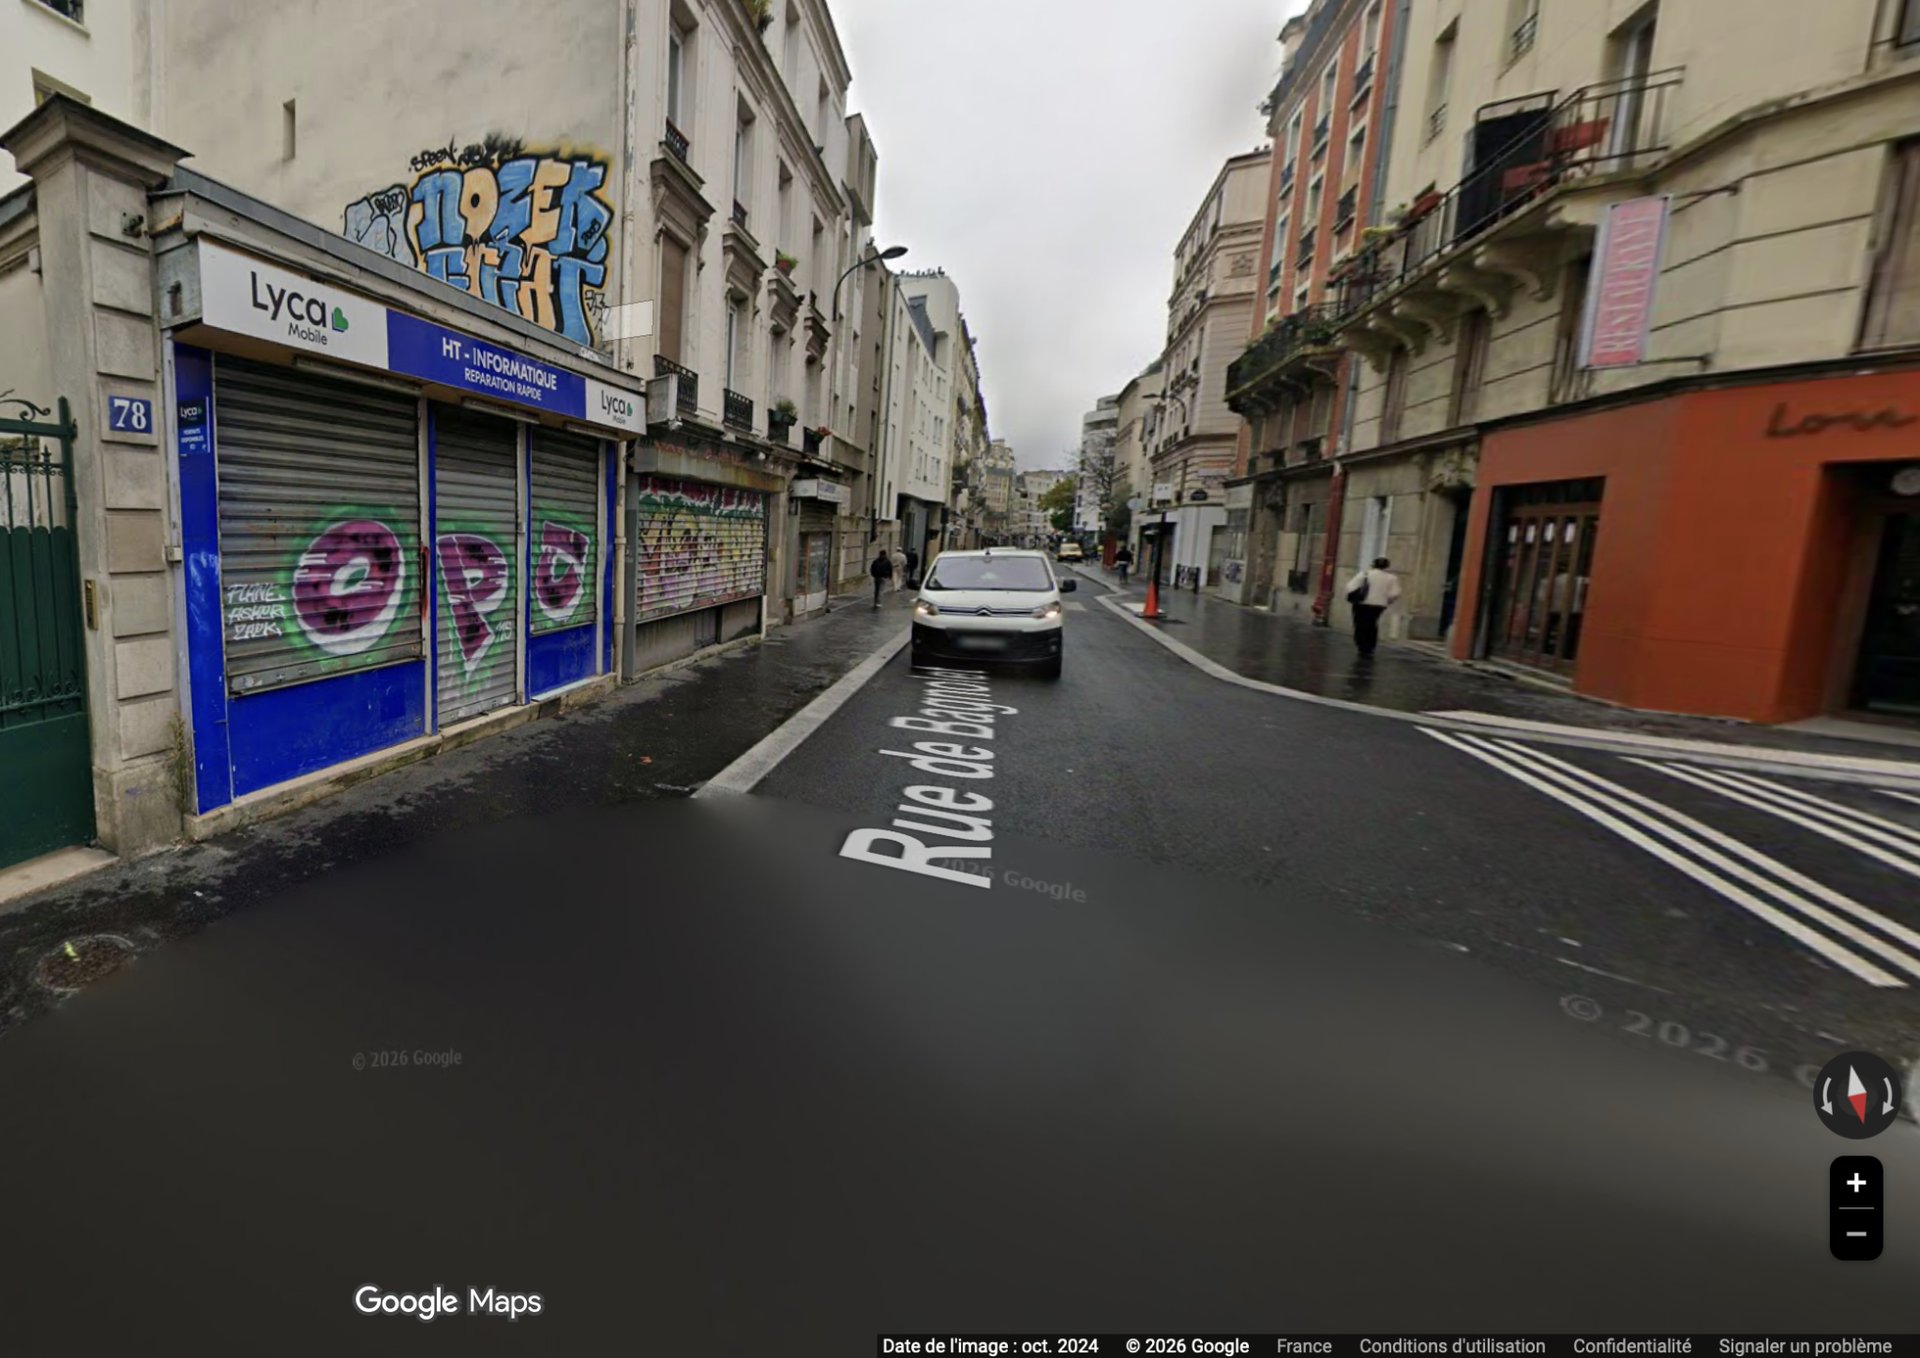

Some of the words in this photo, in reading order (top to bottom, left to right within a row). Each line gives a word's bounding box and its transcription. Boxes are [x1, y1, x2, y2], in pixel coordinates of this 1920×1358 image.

[251, 271, 327, 328] Lyca
[288, 322, 327, 345] Mobile
[442, 337, 461, 360] HT
[473, 347, 557, 390] INFORMATIQUE
[465, 367, 516, 394] REPARATION
[516, 382, 542, 401] RAPIDE
[114, 399, 147, 429] 78
[180, 406, 197, 418] Lyca
[601, 390, 626, 415] Lyca
